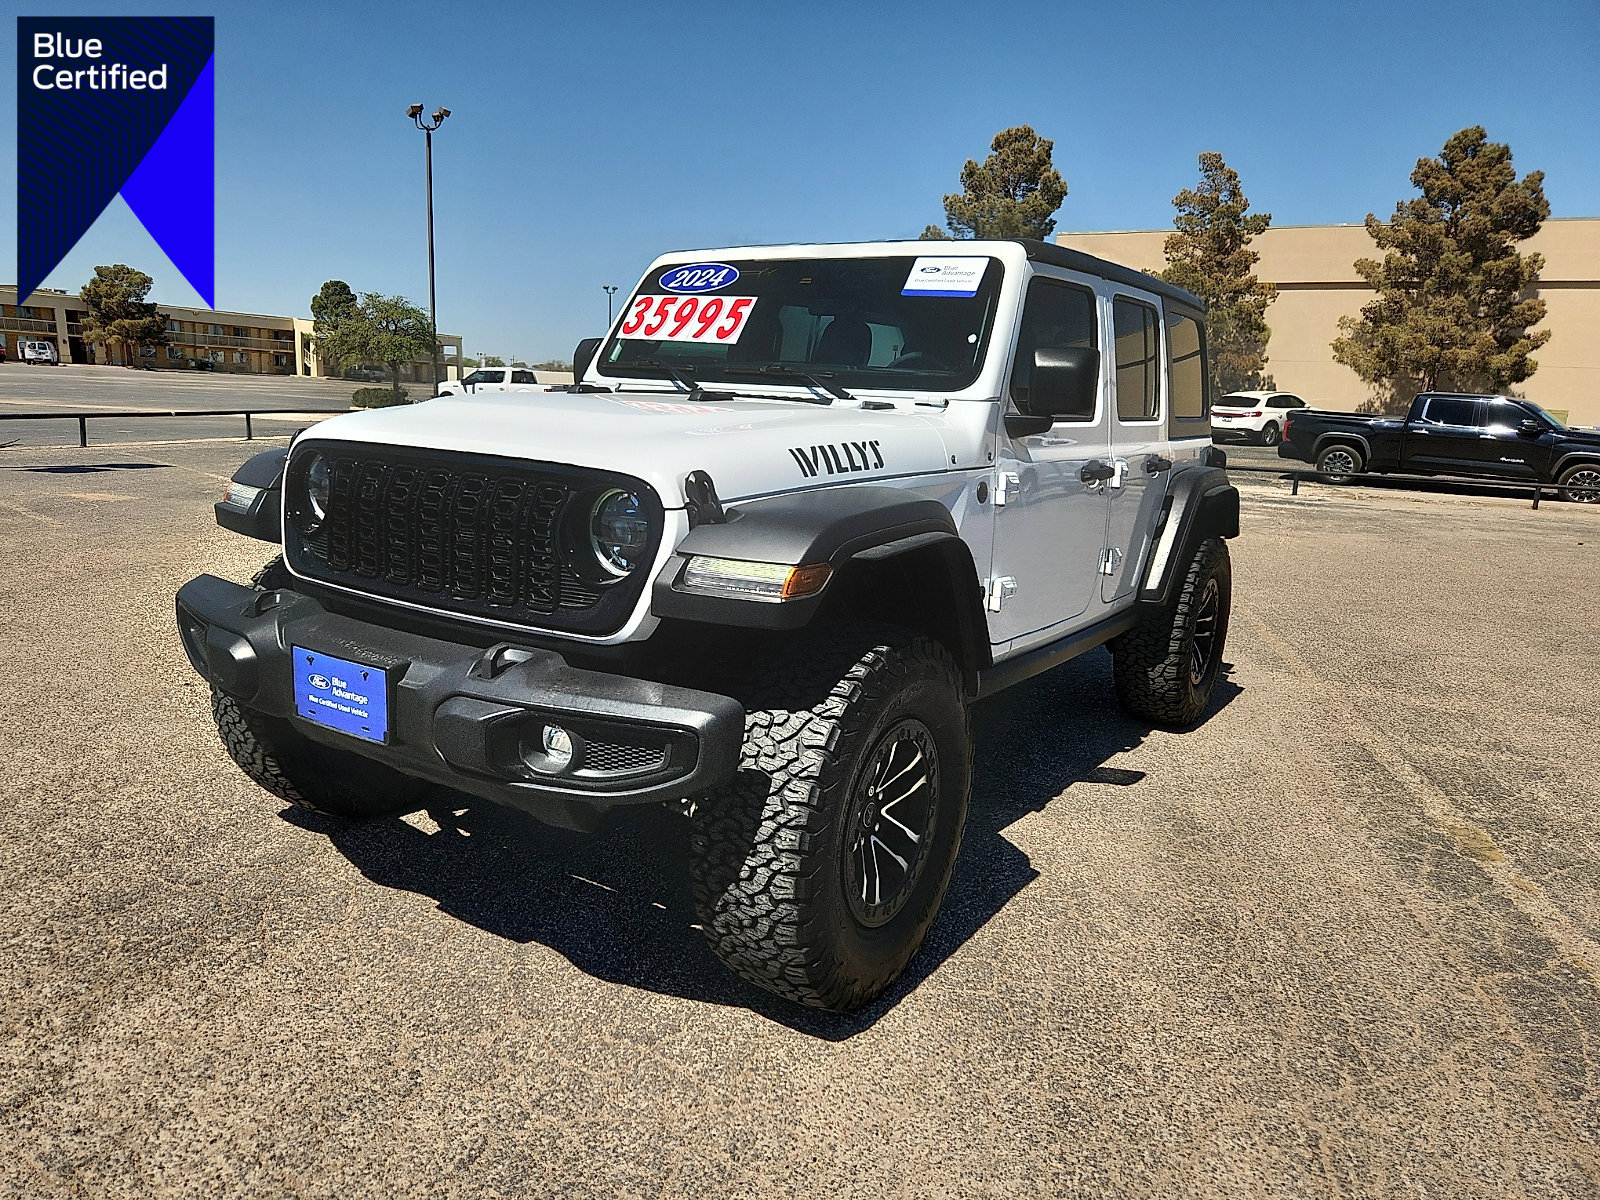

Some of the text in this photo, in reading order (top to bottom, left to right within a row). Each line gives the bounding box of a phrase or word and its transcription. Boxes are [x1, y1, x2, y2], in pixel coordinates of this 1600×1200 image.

[667, 268, 730, 288] 2024
[622, 296, 753, 340] 35995
[787, 440, 885, 478] WILLYS
[331, 676, 348, 689] Blue
[318, 697, 338, 710] Certified
[331, 687, 369, 705] Advantage
